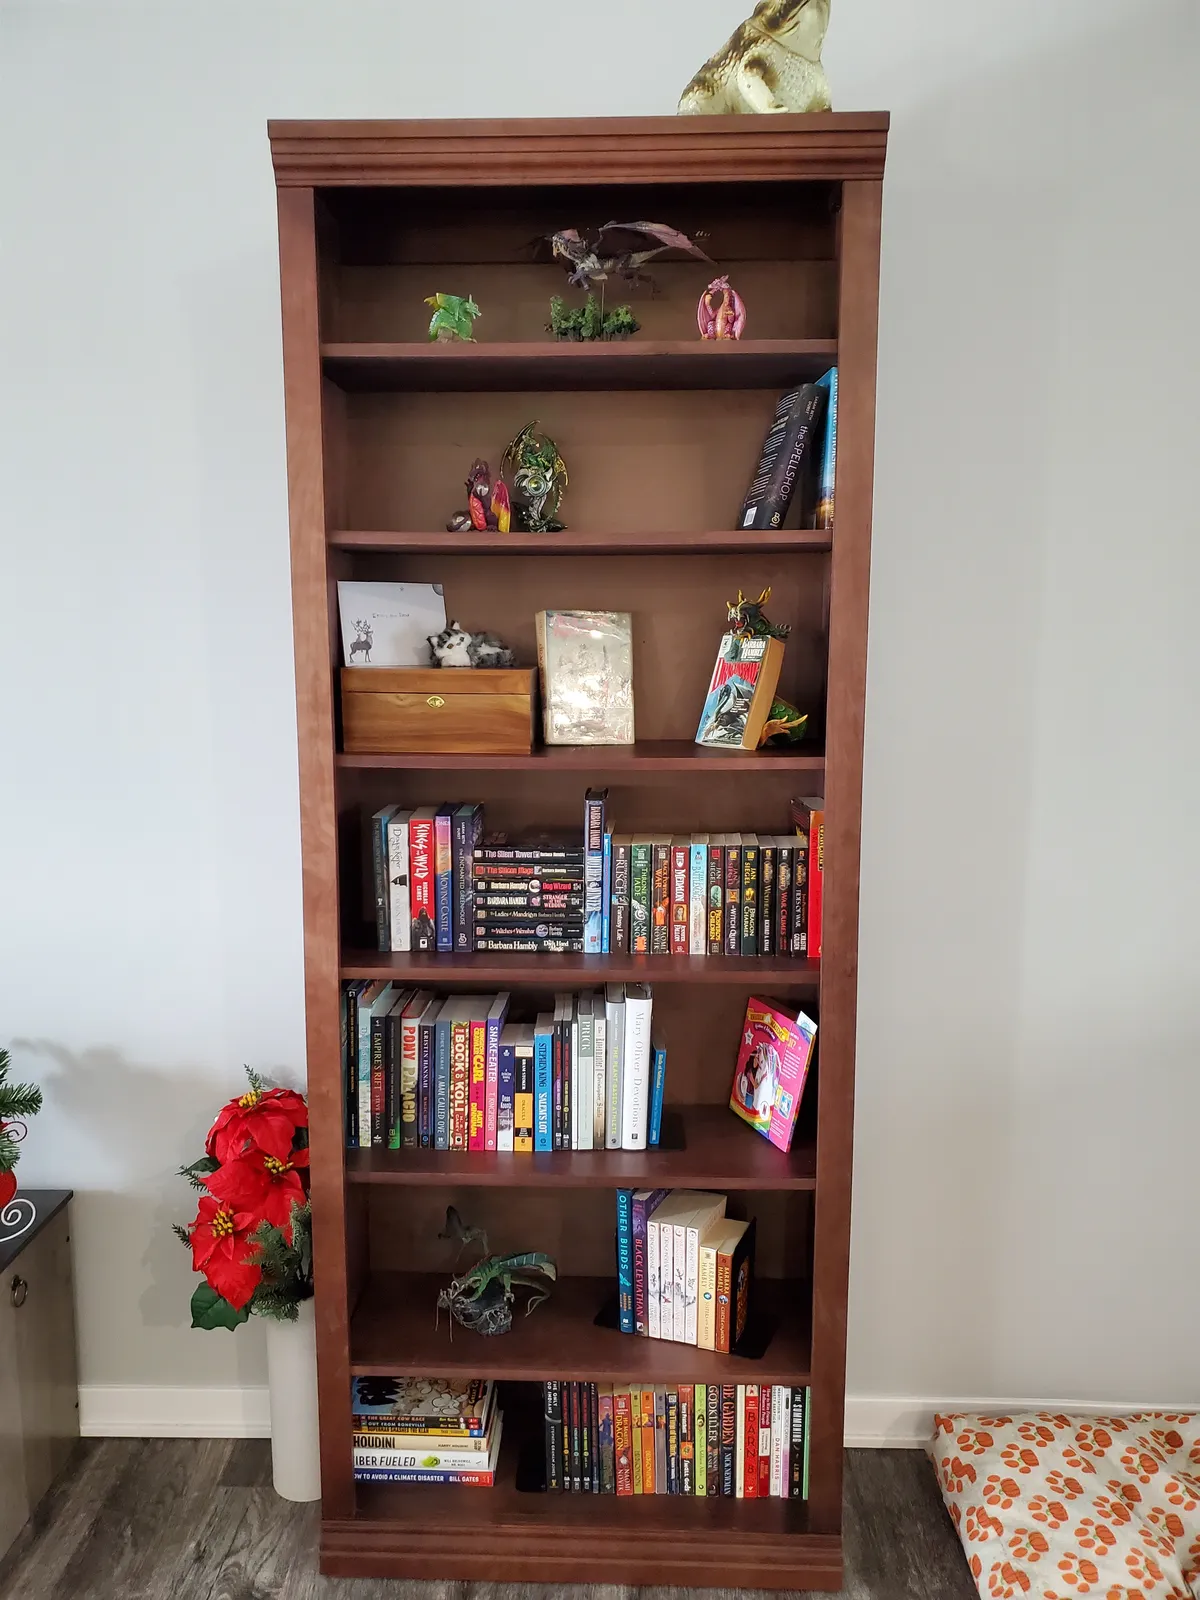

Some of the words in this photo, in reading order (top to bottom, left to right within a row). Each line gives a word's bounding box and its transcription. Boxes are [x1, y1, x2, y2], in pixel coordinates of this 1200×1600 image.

[780, 440, 805, 501] SPELLSHOP
[412, 824, 430, 850] KINGS
[412, 854, 429, 878] WYLD
[615, 860, 624, 894] RUSCH
[440, 906, 450, 931] CASTLE
[488, 941, 513, 949] Barbara
[514, 941, 538, 950] Hambly
[582, 1021, 590, 1050] PRICK
[632, 1012, 645, 1036] Mary
[374, 1033, 382, 1070] EMPIRE'S
[403, 1026, 416, 1060] PONY
[455, 1034, 465, 1072] BOOK
[488, 1026, 498, 1082] SNAKE-EATER
[634, 1041, 643, 1072] Oliver
[374, 1072, 382, 1091] RIFT
[473, 1055, 485, 1084] CARL
[403, 1066, 416, 1122] PALACIO
[455, 1081, 465, 1111] KOLI
[632, 1078, 643, 1128] Devotions
[539, 1122, 547, 1134] LOT
[619, 1195, 628, 1232] OTHER
[620, 1238, 629, 1270] BIRDS
[635, 1269, 644, 1316] LEVIATHAN
[708, 1385, 718, 1442] GODKILLER
[722, 1401, 735, 1444] GARDEN
[792, 1404, 802, 1442] SUMMONING
[380, 1456, 416, 1467] FUELED
